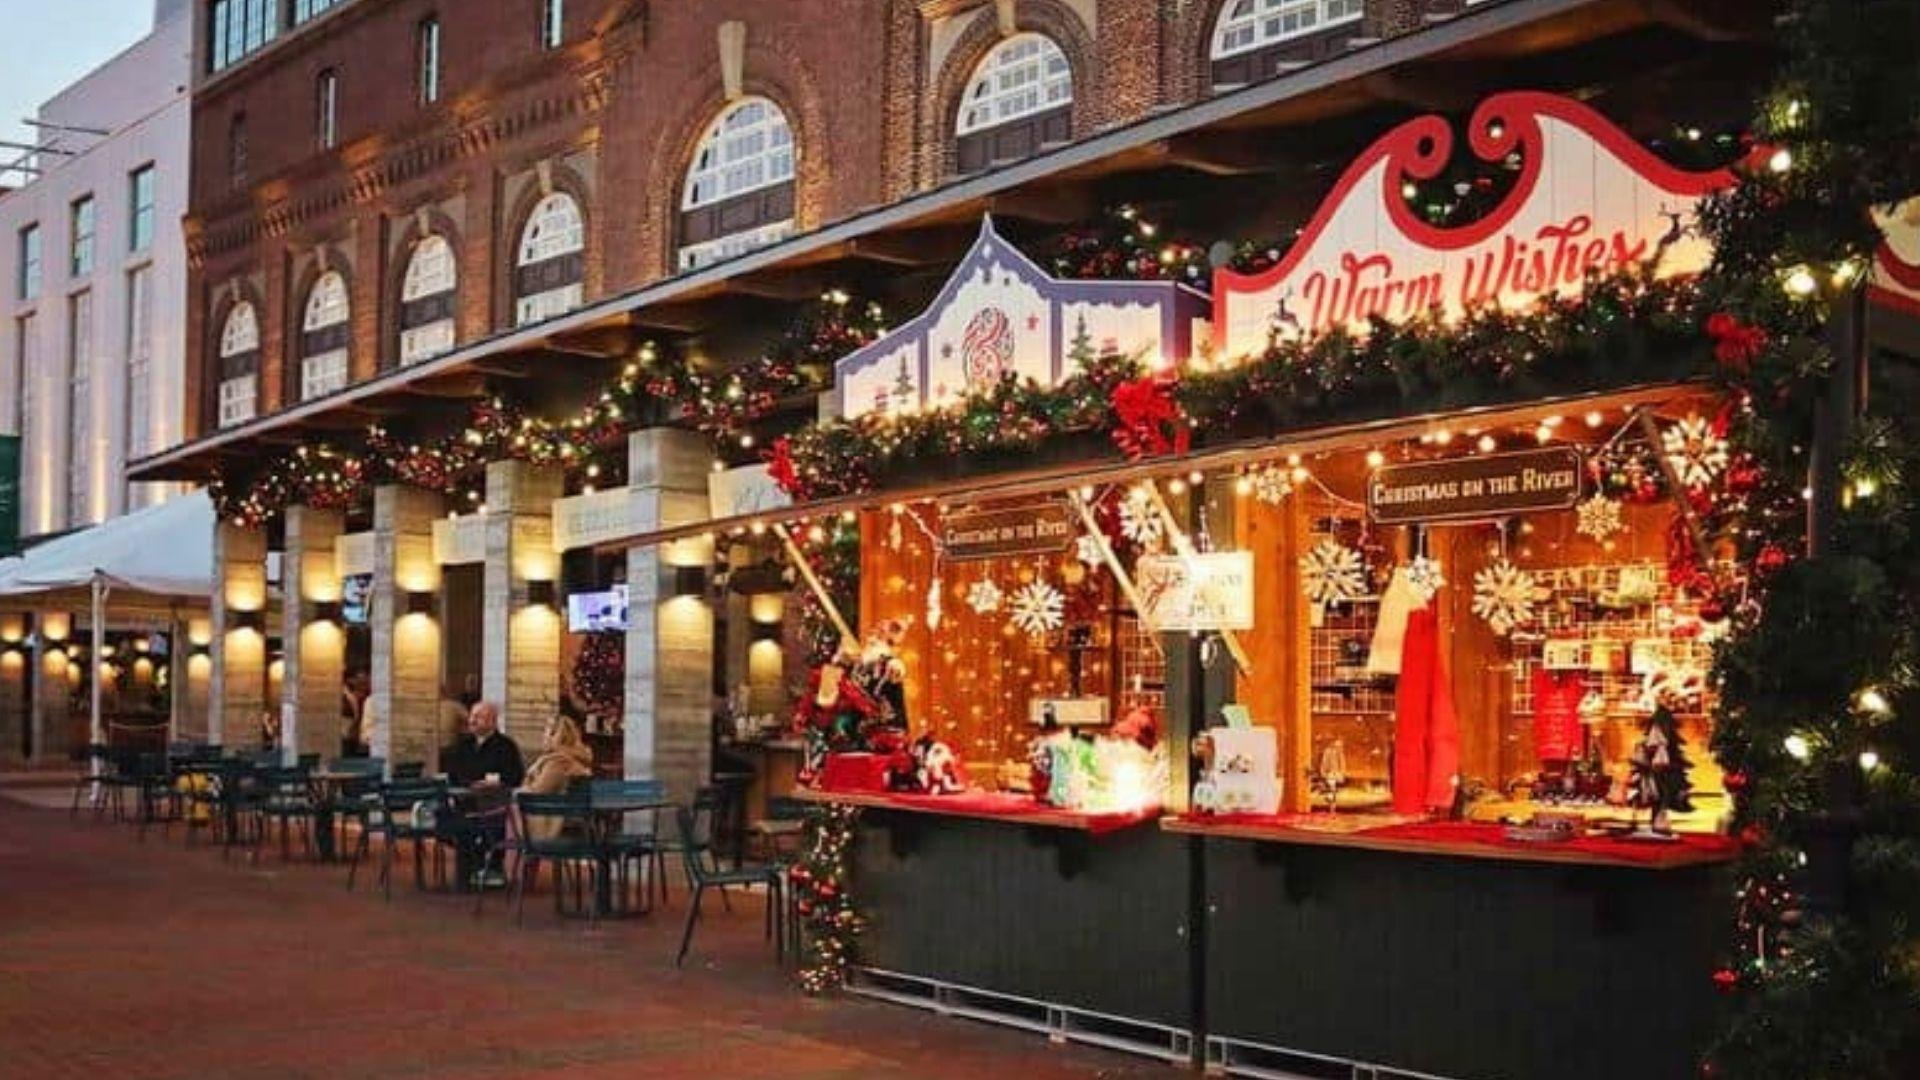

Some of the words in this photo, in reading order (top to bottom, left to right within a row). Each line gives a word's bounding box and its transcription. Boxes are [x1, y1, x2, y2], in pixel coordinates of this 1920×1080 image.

[1303, 253, 1443, 332] Warm
[1462, 215, 1647, 308] Wishes
[1373, 483, 1459, 504] CHRISTMAS
[1462, 478, 1483, 497] ON
[1488, 475, 1518, 495] THE
[1522, 468, 1575, 492] RIVER
